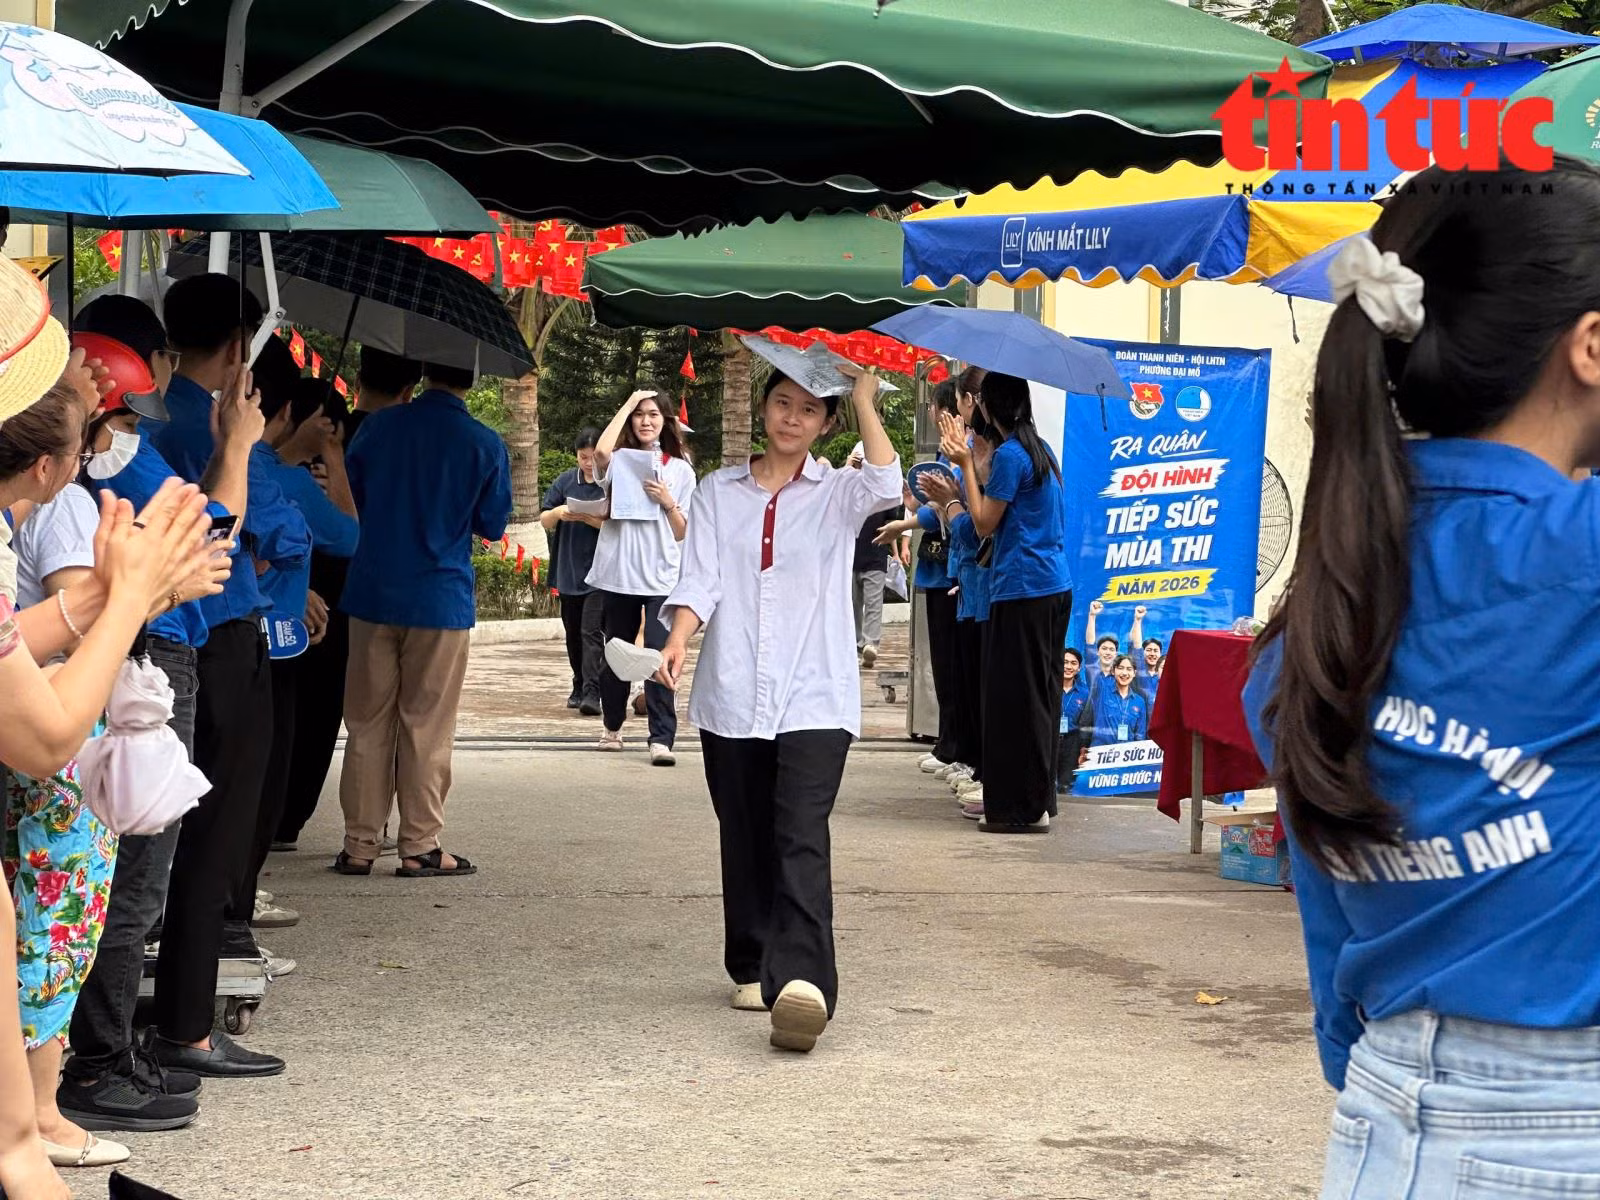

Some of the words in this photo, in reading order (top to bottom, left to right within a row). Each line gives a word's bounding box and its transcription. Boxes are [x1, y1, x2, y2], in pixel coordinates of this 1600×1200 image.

[1005, 232, 1021, 248] LILY
[1027, 226, 1055, 252] KÍNH
[1057, 222, 1083, 251] MẮT
[1085, 227, 1111, 250] LILY
[1115, 350, 1137, 361] ĐOÀN
[1139, 352, 1164, 363] THANH
[1166, 353, 1184, 364] NIÊN
[1191, 354, 1204, 366] HỘI
[1206, 356, 1226, 366] LHTN
[1139, 365, 1171, 376] PHƯỜNG
[1173, 368, 1186, 378] ĐẠI
[1110, 436, 1143, 461] RA
[1148, 429, 1207, 456] QUÂN
[1121, 469, 1158, 493] ĐỘI
[1162, 466, 1212, 487] HÌNH
[1106, 498, 1160, 535] TIẾP
[1164, 494, 1219, 529] SỨC
[1104, 535, 1162, 570] MÙA
[1171, 534, 1213, 563] THI
[1117, 578, 1156, 596] NĂM
[1159, 576, 1200, 592] 2026
[1374, 695, 1437, 745] HỌC
[1097, 748, 1121, 764] TIẾP
[1122, 747, 1145, 762] SỨC
[1088, 774, 1119, 788] VỮNG
[1121, 769, 1152, 785] BƯỚC
[1462, 810, 1552, 873] ANH
